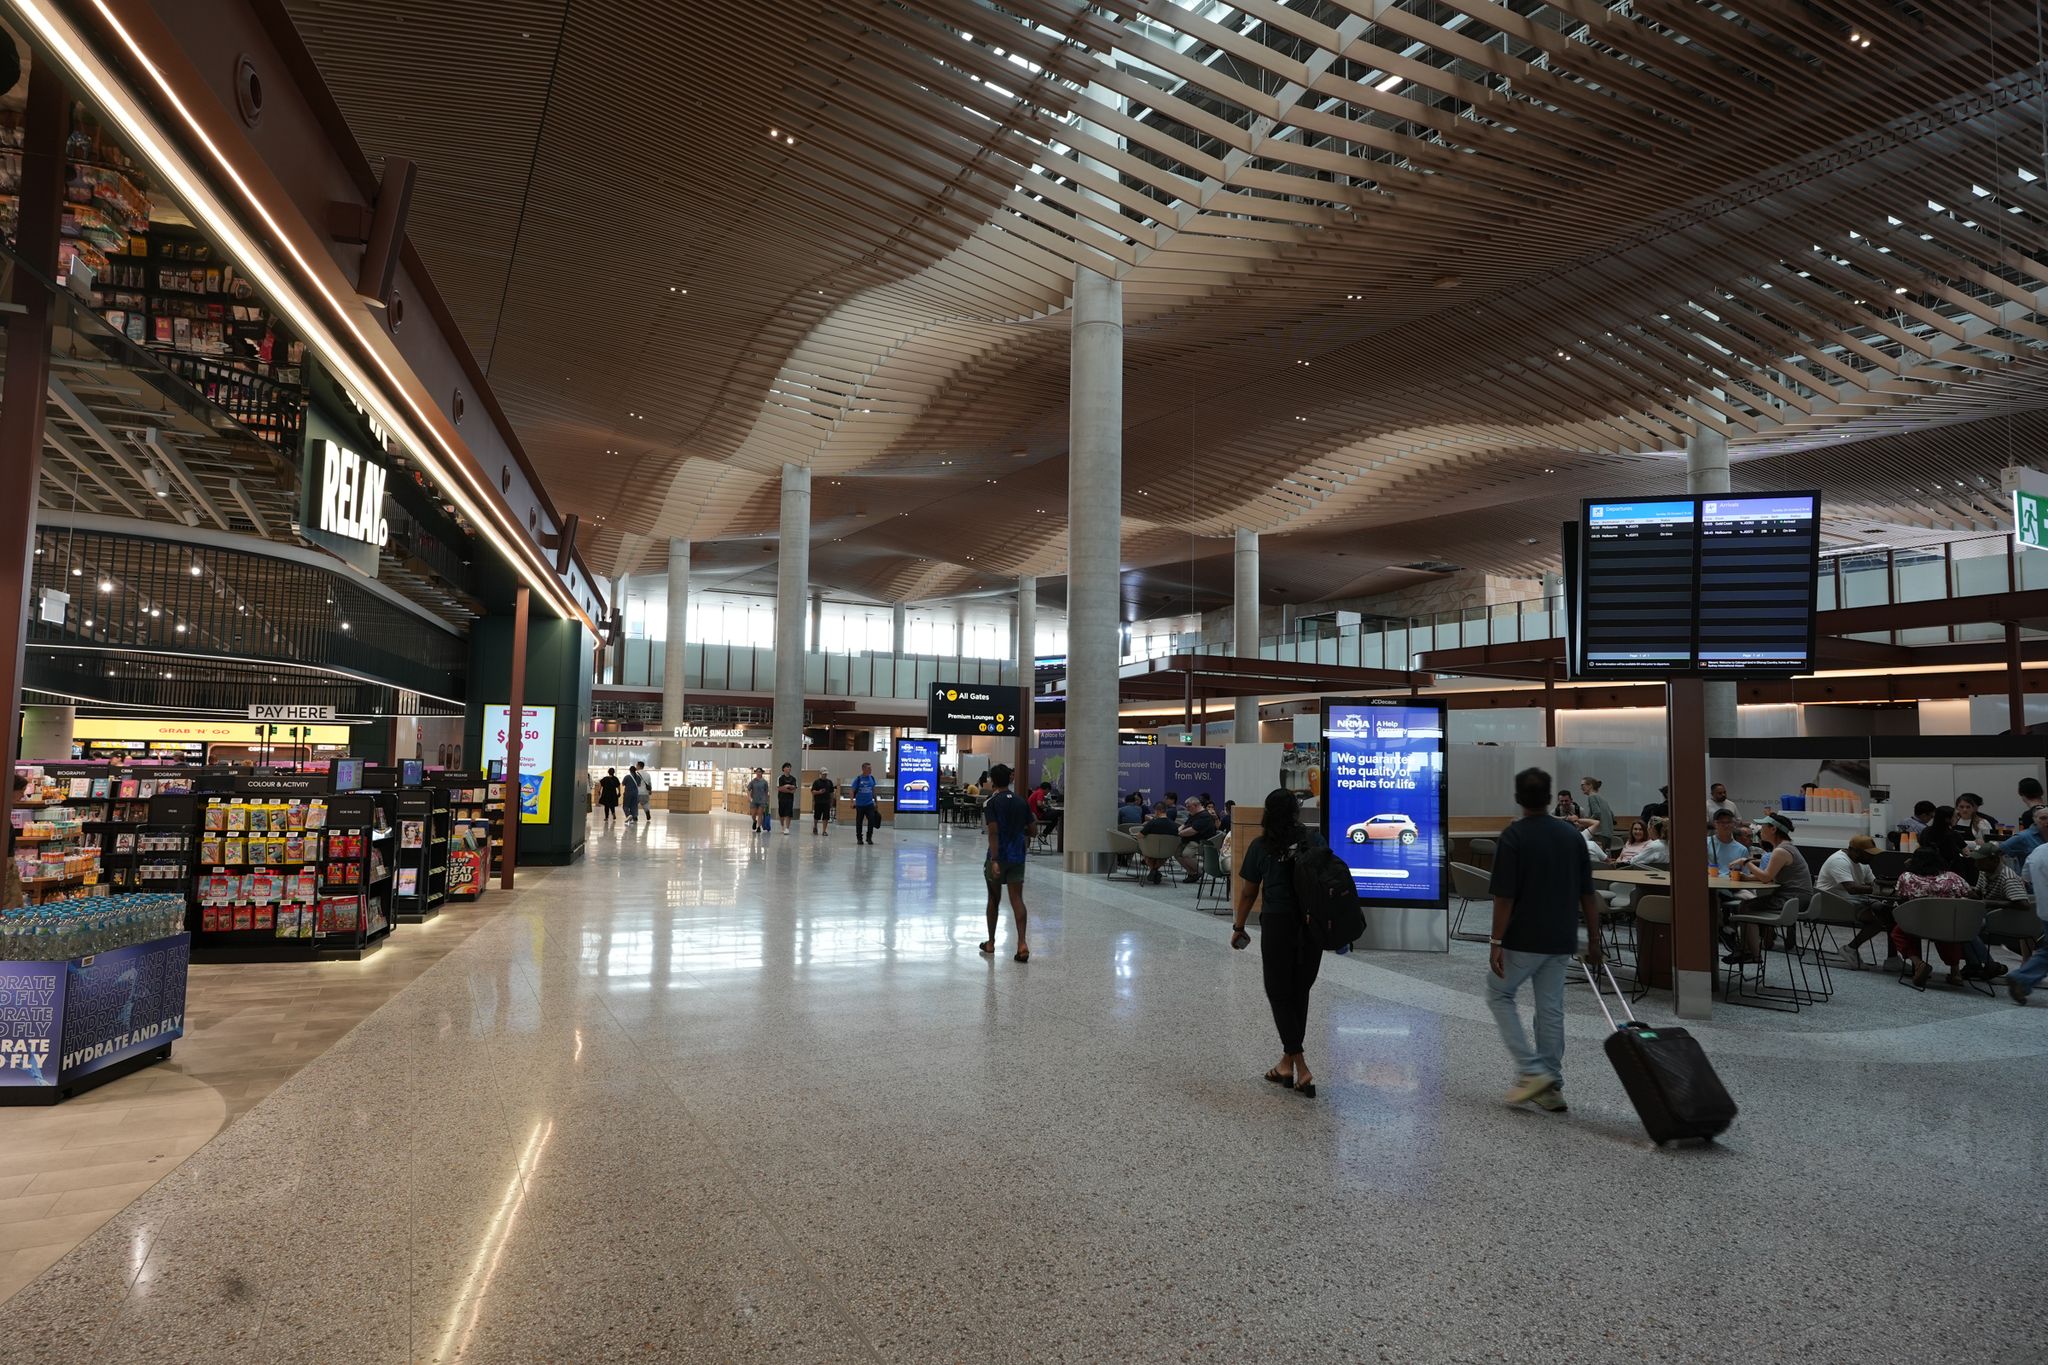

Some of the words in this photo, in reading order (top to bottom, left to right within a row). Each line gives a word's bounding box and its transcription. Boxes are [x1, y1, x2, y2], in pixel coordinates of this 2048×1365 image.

[958, 692, 969, 700] All
[969, 693, 990, 701] Gates
[256, 707, 285, 718] PAY
[287, 707, 328, 719] HERE
[1337, 720, 1370, 728] NRMA
[709, 729, 744, 737] SUNGLASSES
[1175, 760, 1208, 769] Discover
[1209, 761, 1222, 769] the
[1337, 753, 1356, 763] We
[1175, 772, 1193, 780] from
[1194, 772, 1212, 781] WSI.
[1337, 765, 1356, 775] the
[1358, 766, 1397, 778] quality
[1337, 779, 1376, 790] repairs
[1378, 778, 1395, 789] for
[1396, 779, 1416, 789] life
[138, 950, 166, 967] AND
[166, 944, 189, 962] FLY
[165, 958, 187, 976] FLY
[164, 972, 186, 991] FLY
[15, 990, 55, 1006] FLY
[163, 986, 185, 1005] FLY
[12, 1021, 52, 1038] FLY
[62, 1034, 129, 1070] HYDRATE
[130, 1023, 159, 1045] AND
[160, 1014, 183, 1034] FLY
[10, 1053, 48, 1069] FLY
